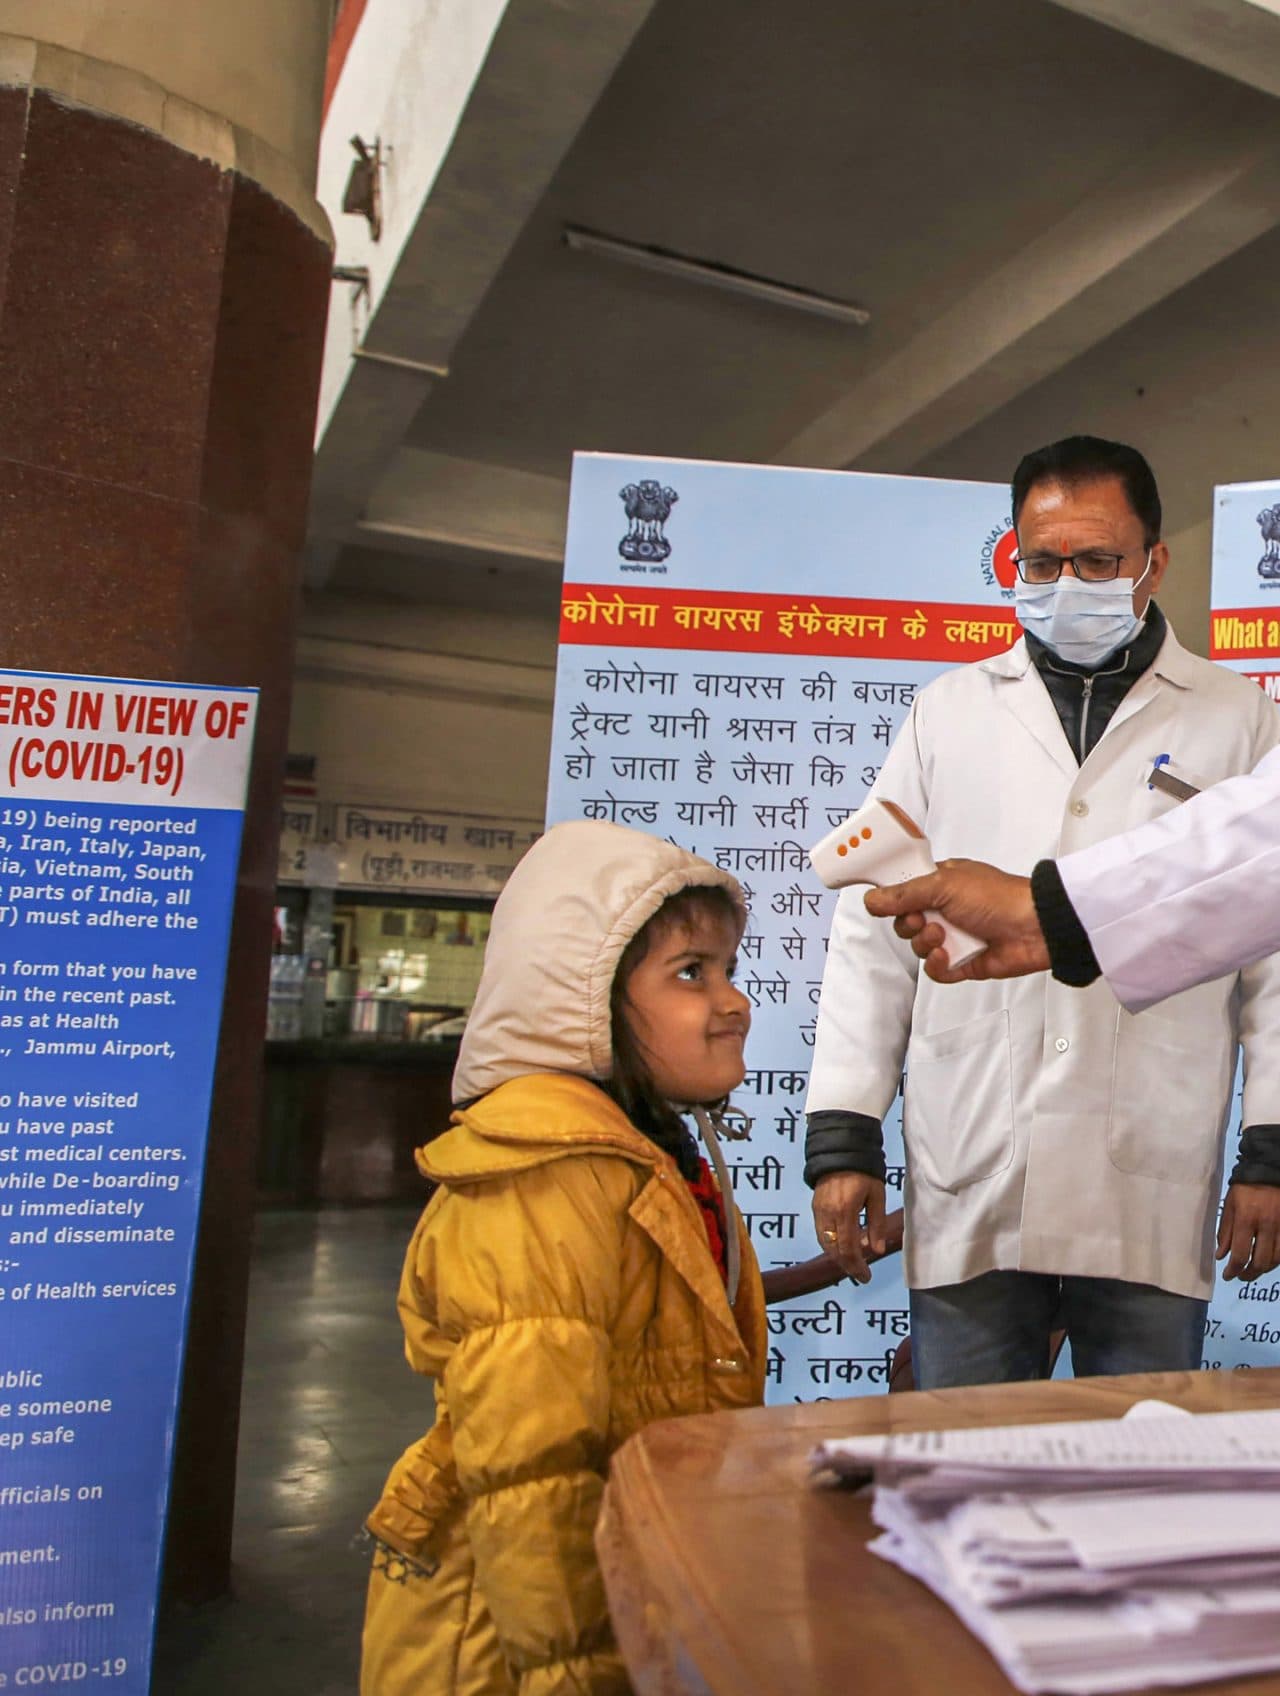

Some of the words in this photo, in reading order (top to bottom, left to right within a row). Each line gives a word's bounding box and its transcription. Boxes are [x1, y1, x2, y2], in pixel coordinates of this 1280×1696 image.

[981, 525, 1005, 585] NATIONAL
[562, 592, 659, 626] कोरोना
[673, 607, 763, 632] वायरस
[778, 604, 887, 638] इंफेक्शन
[902, 610, 928, 639] के
[944, 621, 1015, 644] लक्षण
[1214, 618, 1264, 649] What
[584, 661, 678, 695] कोरोना
[693, 674, 785, 699] वायरस
[800, 671, 837, 702] की
[66, 691, 104, 730] IN
[115, 695, 198, 736] VIEW
[205, 701, 248, 739] OF
[570, 702, 632, 740] ट्रैक्ट
[648, 708, 710, 739] यानी
[812, 715, 856, 745] तंत्र
[9, 737, 183, 796] (COVID-19)
[565, 746, 596, 779] हो
[611, 757, 679, 781] जाता
[695, 750, 716, 784] है
[731, 752, 794, 785] जैसा
[809, 755, 846, 787] कि
[581, 790, 659, 823] कोल्ड
[675, 795, 737, 827] यानी
[752, 797, 809, 829] सर्दी
[45, 811, 102, 833] being
[109, 816, 197, 839] reported
[20, 835, 71, 855] Iran,
[80, 838, 134, 858] Italy,
[141, 841, 206, 861] Japan,
[36, 859, 127, 881] Vietnam,
[135, 864, 193, 880] South
[9, 885, 65, 902] parts
[72, 885, 94, 901] of
[99, 886, 158, 907] India,
[166, 889, 190, 904] all
[771, 883, 822, 916] और
[26, 910, 80, 925] must
[87, 910, 158, 928] adhere
[165, 913, 198, 929] the
[780, 927, 806, 960] से
[14, 960, 59, 976] form
[67, 962, 106, 977] that
[112, 967, 145, 981] you
[152, 964, 197, 980] have
[24, 987, 56, 1002] the
[63, 990, 124, 1003] recent
[130, 991, 175, 1007] past.
[744, 970, 790, 1007] ऐसे
[29, 1014, 50, 1027] at
[56, 1014, 119, 1028] Health
[24, 1039, 96, 1054] Jammu
[102, 1040, 175, 1059] Airport,
[18, 1092, 67, 1107] have
[74, 1092, 138, 1107] visited
[17, 1118, 64, 1134] have
[71, 1120, 114, 1137] past
[774, 1107, 801, 1142] में
[25, 1145, 103, 1161] medical
[109, 1146, 187, 1162] centers.
[21, 1199, 144, 1218] immediately
[10, 1227, 48, 1244] and
[54, 1226, 174, 1243] disseminate
[12, 1283, 32, 1300] of
[37, 1282, 96, 1299] Health
[103, 1280, 176, 1297] services
[767, 1301, 846, 1335] उल्टी
[18, 1400, 111, 1416] someone
[31, 1426, 74, 1444] safe
[78, 1486, 102, 1500] on
[45, 1601, 114, 1621] inform
